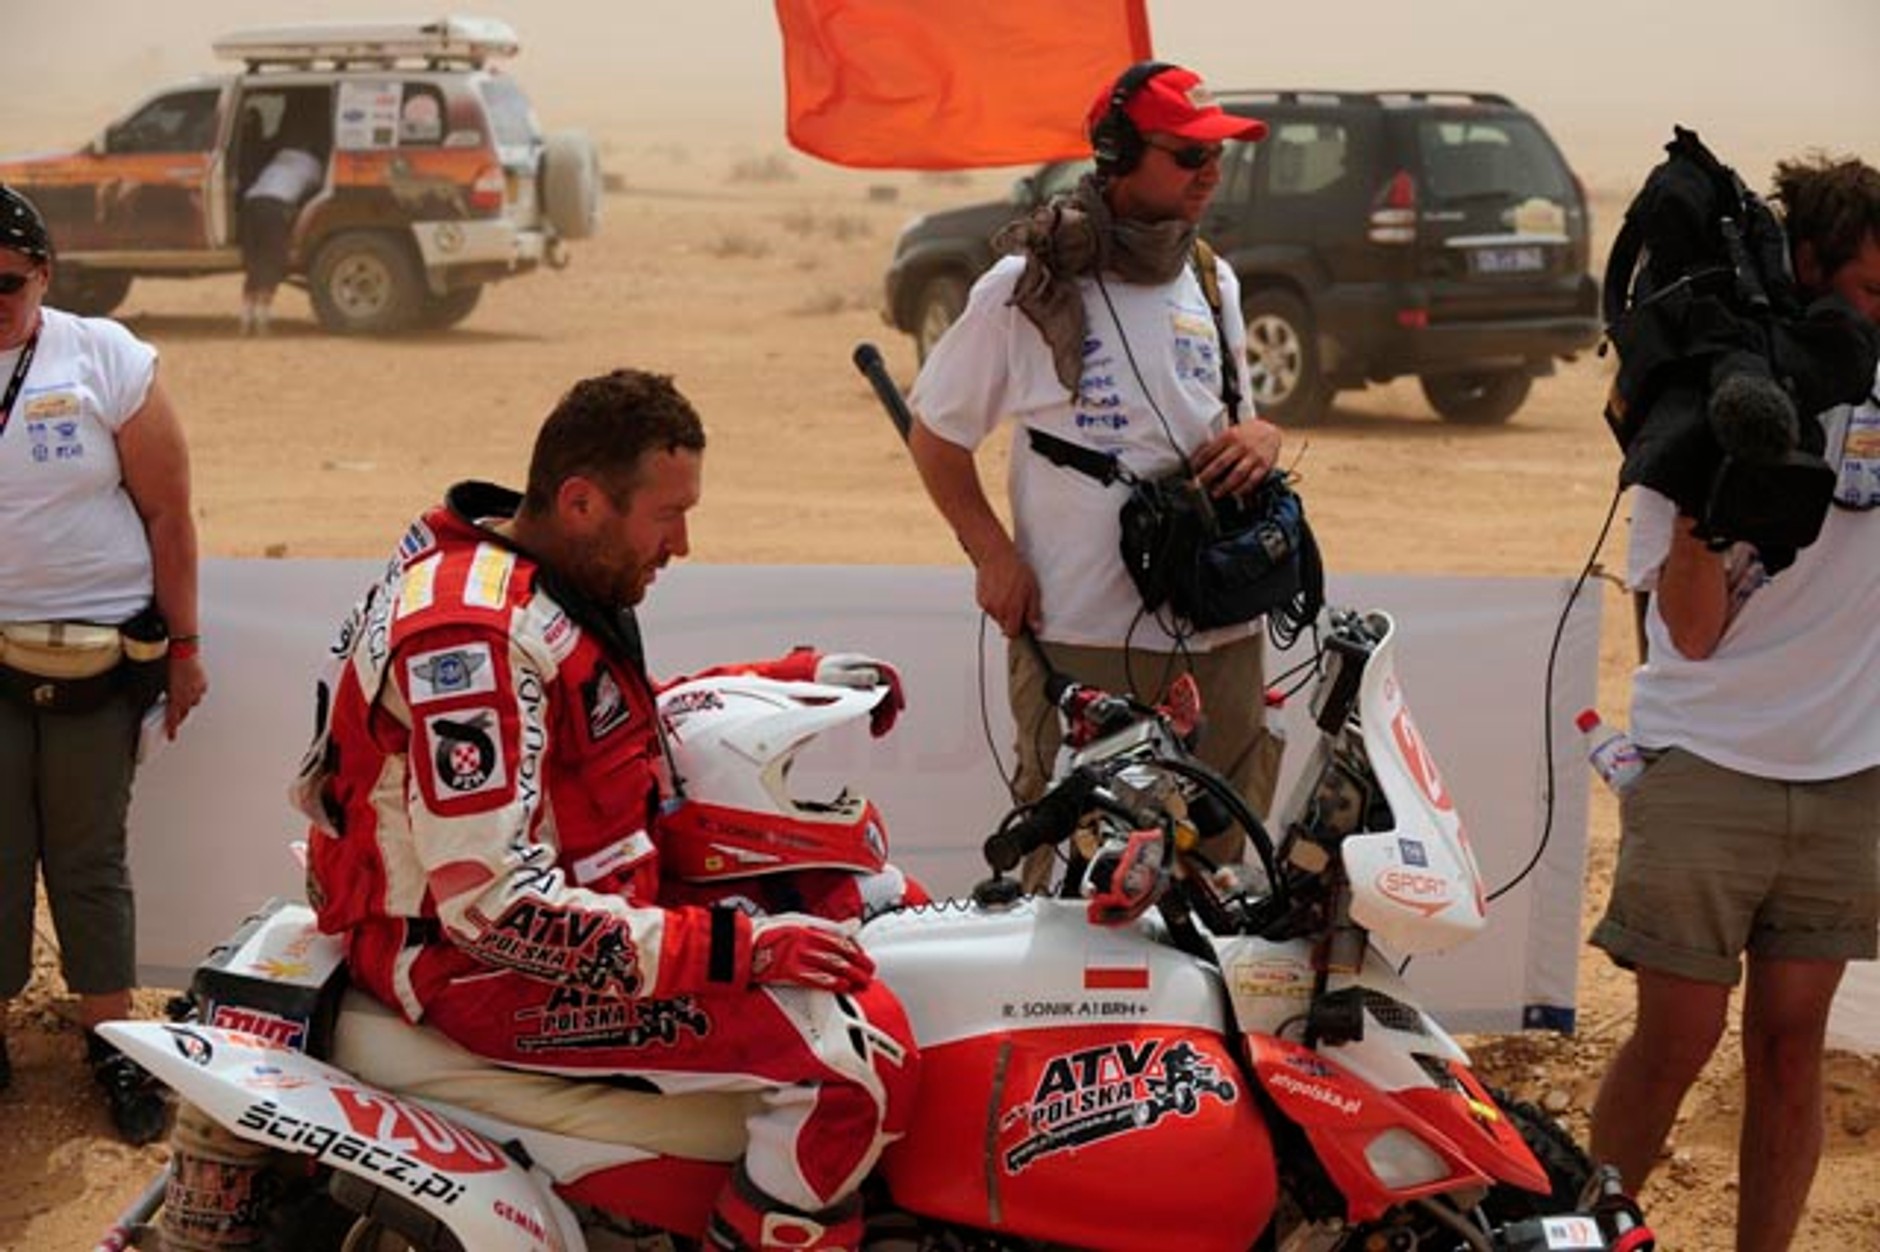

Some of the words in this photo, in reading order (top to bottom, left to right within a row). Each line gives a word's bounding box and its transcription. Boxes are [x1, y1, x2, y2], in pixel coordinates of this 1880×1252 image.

[1385, 872, 1447, 895] SPORT
[495, 902, 604, 948] ATV
[481, 933, 566, 966] POLSKA
[542, 1003, 625, 1031] POLSKA
[1022, 1001, 1073, 1017] SONIK
[1034, 1040, 1160, 1103] ATV
[1031, 1081, 1133, 1126] POLSKA
